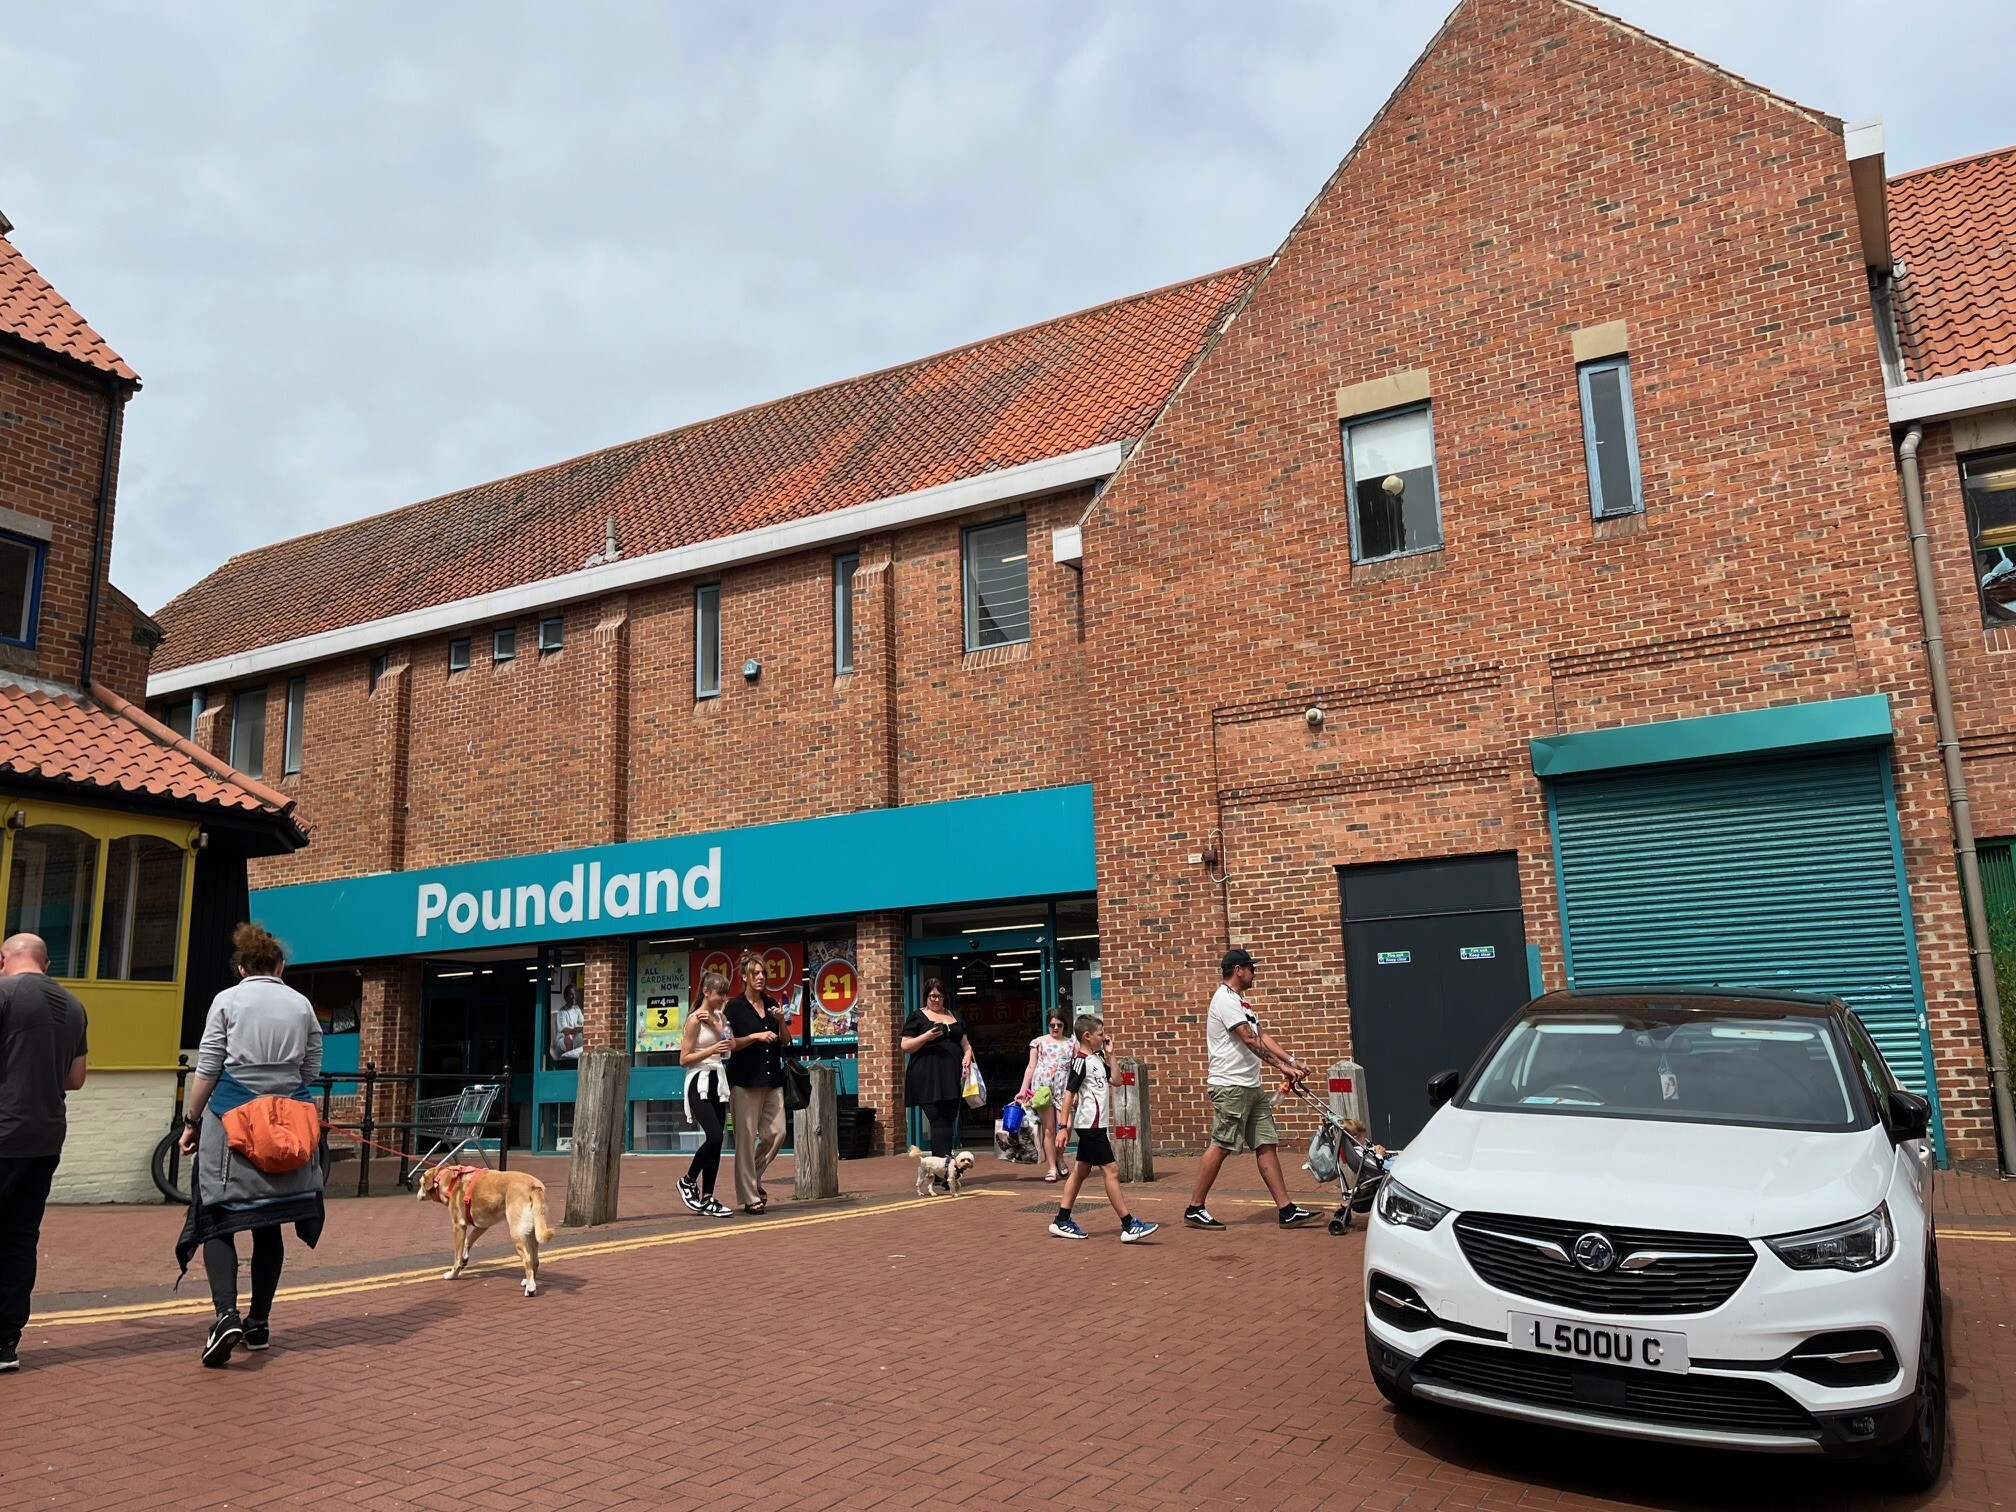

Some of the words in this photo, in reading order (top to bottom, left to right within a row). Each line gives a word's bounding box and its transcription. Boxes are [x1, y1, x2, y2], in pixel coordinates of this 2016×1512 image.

[416, 846, 722, 938] Poundland
[644, 968, 659, 976] ALL
[767, 959, 786, 979] £1
[641, 974, 685, 984] GARDENING
[823, 973, 851, 999] £1
[660, 998, 667, 1006] 4
[656, 1009, 669, 1028] 3
[1534, 1320, 1632, 1362] L500U
[1642, 1337, 1661, 1366] C
